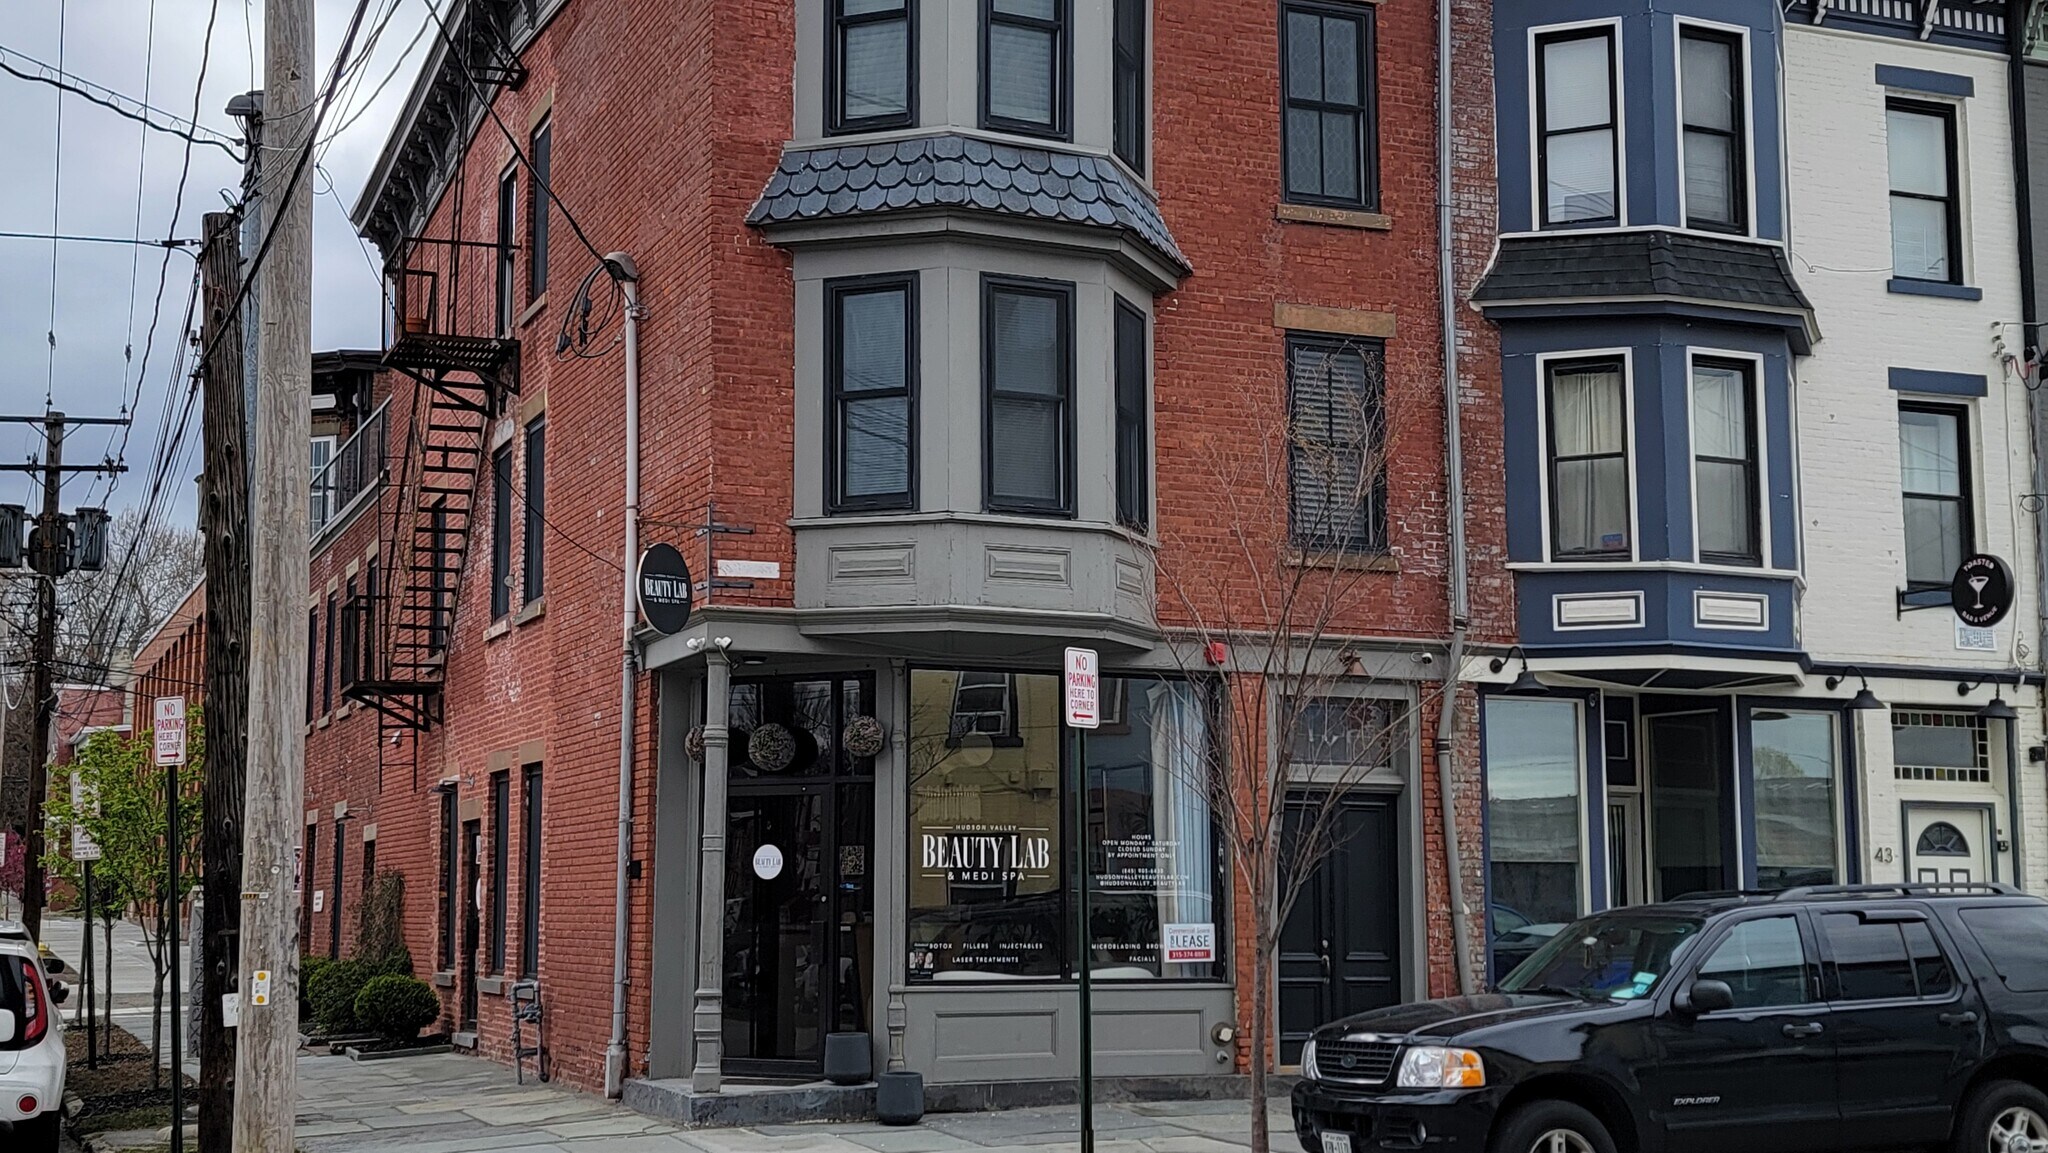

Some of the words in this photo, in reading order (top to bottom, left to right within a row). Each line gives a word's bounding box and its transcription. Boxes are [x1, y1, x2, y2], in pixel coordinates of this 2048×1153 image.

[1963, 558, 1995, 572] TOASTED
[644, 577, 672, 598] BEAUTY
[673, 580, 688, 599] LAB
[1961, 610, 1974, 622] BAR
[1979, 605, 1998, 623] VENUE
[1075, 655, 1088, 671] NO
[1068, 672, 1096, 689] PARKING
[1069, 688, 1086, 699] HERE
[1086, 689, 1095, 700] TO
[164, 703, 176, 716] NO
[1070, 699, 1095, 711] CORNER
[157, 717, 184, 731] PARKING
[158, 731, 174, 741] HERE
[989, 824, 1017, 832] VALLEY
[921, 833, 1004, 870] BEAUTY
[1010, 834, 1050, 870] LAB
[1874, 847, 1894, 864] 43
[947, 871, 955, 881] &
[962, 871, 995, 881] MEDI
[1002, 871, 1025, 881] SPA
[1175, 935, 1210, 948] LEASE
[975, 956, 1019, 964] TREATMENTS
[1673, 1095, 1721, 1106] EXPLORER
